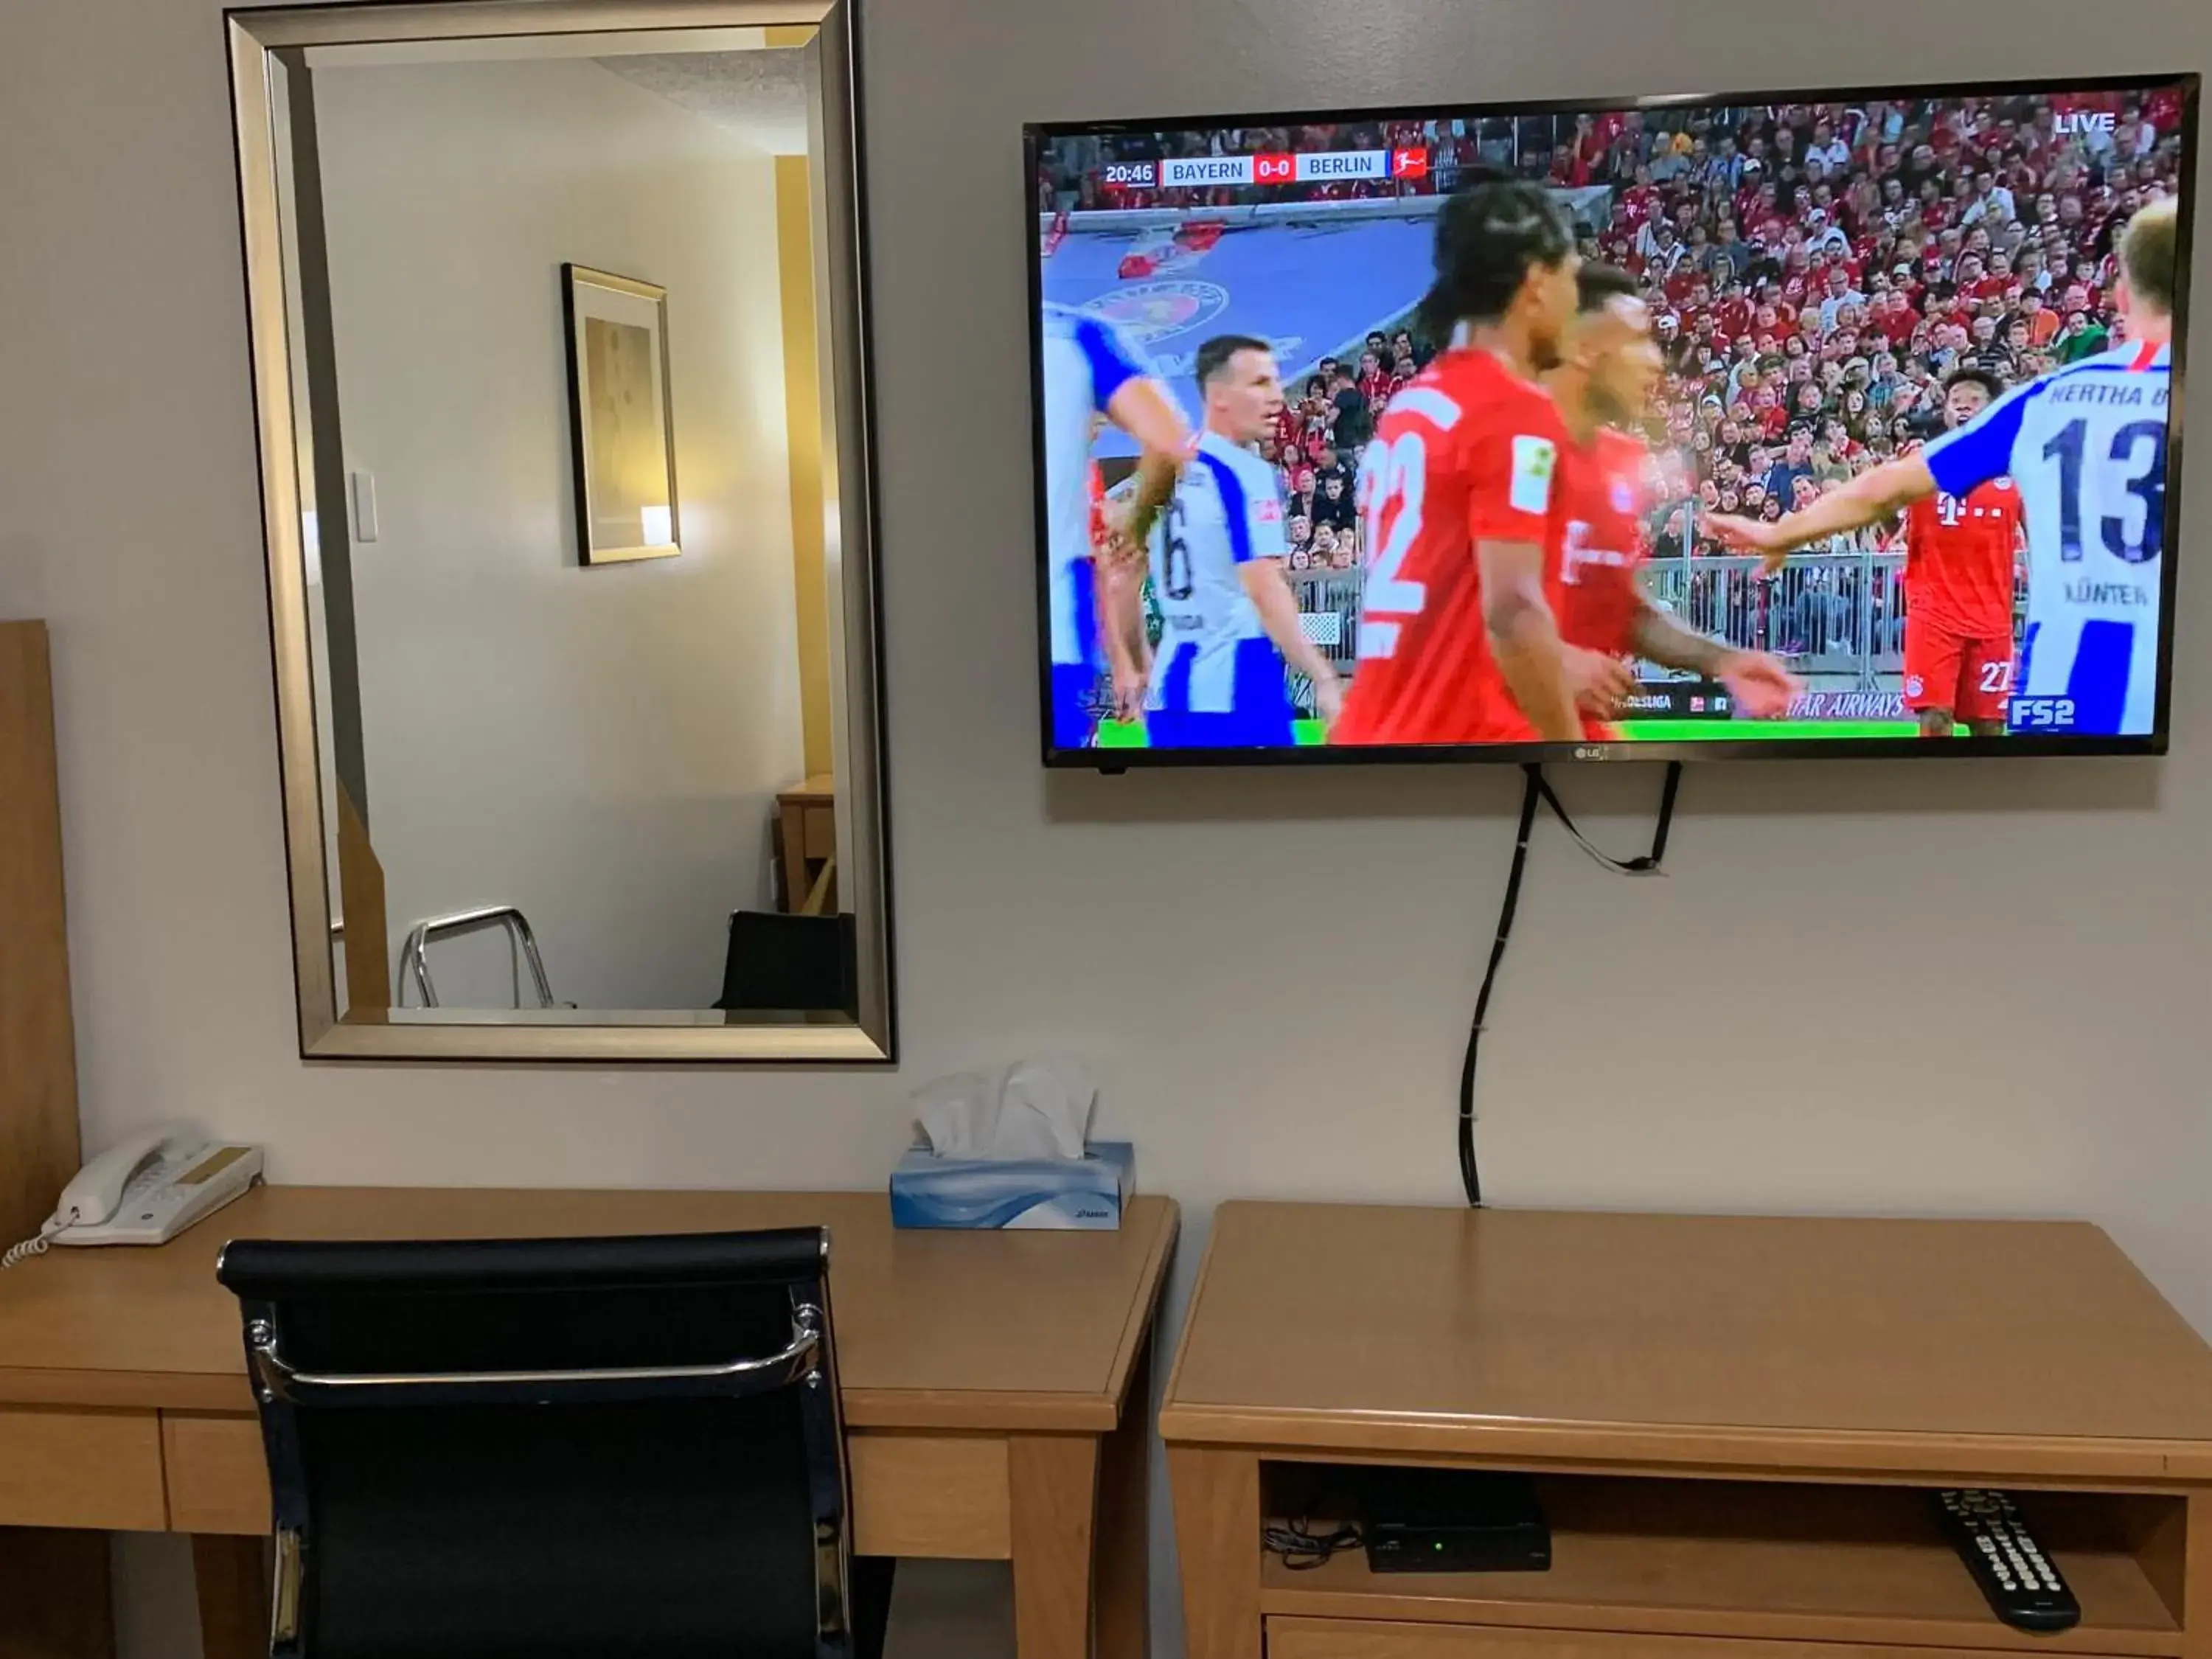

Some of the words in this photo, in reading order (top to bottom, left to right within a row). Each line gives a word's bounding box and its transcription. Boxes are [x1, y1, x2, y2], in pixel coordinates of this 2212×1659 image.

[2054, 112, 2115, 133] LIVE
[1106, 165, 1153, 182] 20:46
[1173, 162, 1243, 180] BAYERN
[1259, 160, 1290, 177] 0-0
[1310, 156, 1372, 174] BERLIN
[2049, 383, 2143, 406] HERTHA
[2042, 417, 2167, 563] 13
[1980, 661, 2016, 692] 27
[1827, 693, 1904, 717] AIRWAYS
[2011, 700, 2075, 725] FS2
